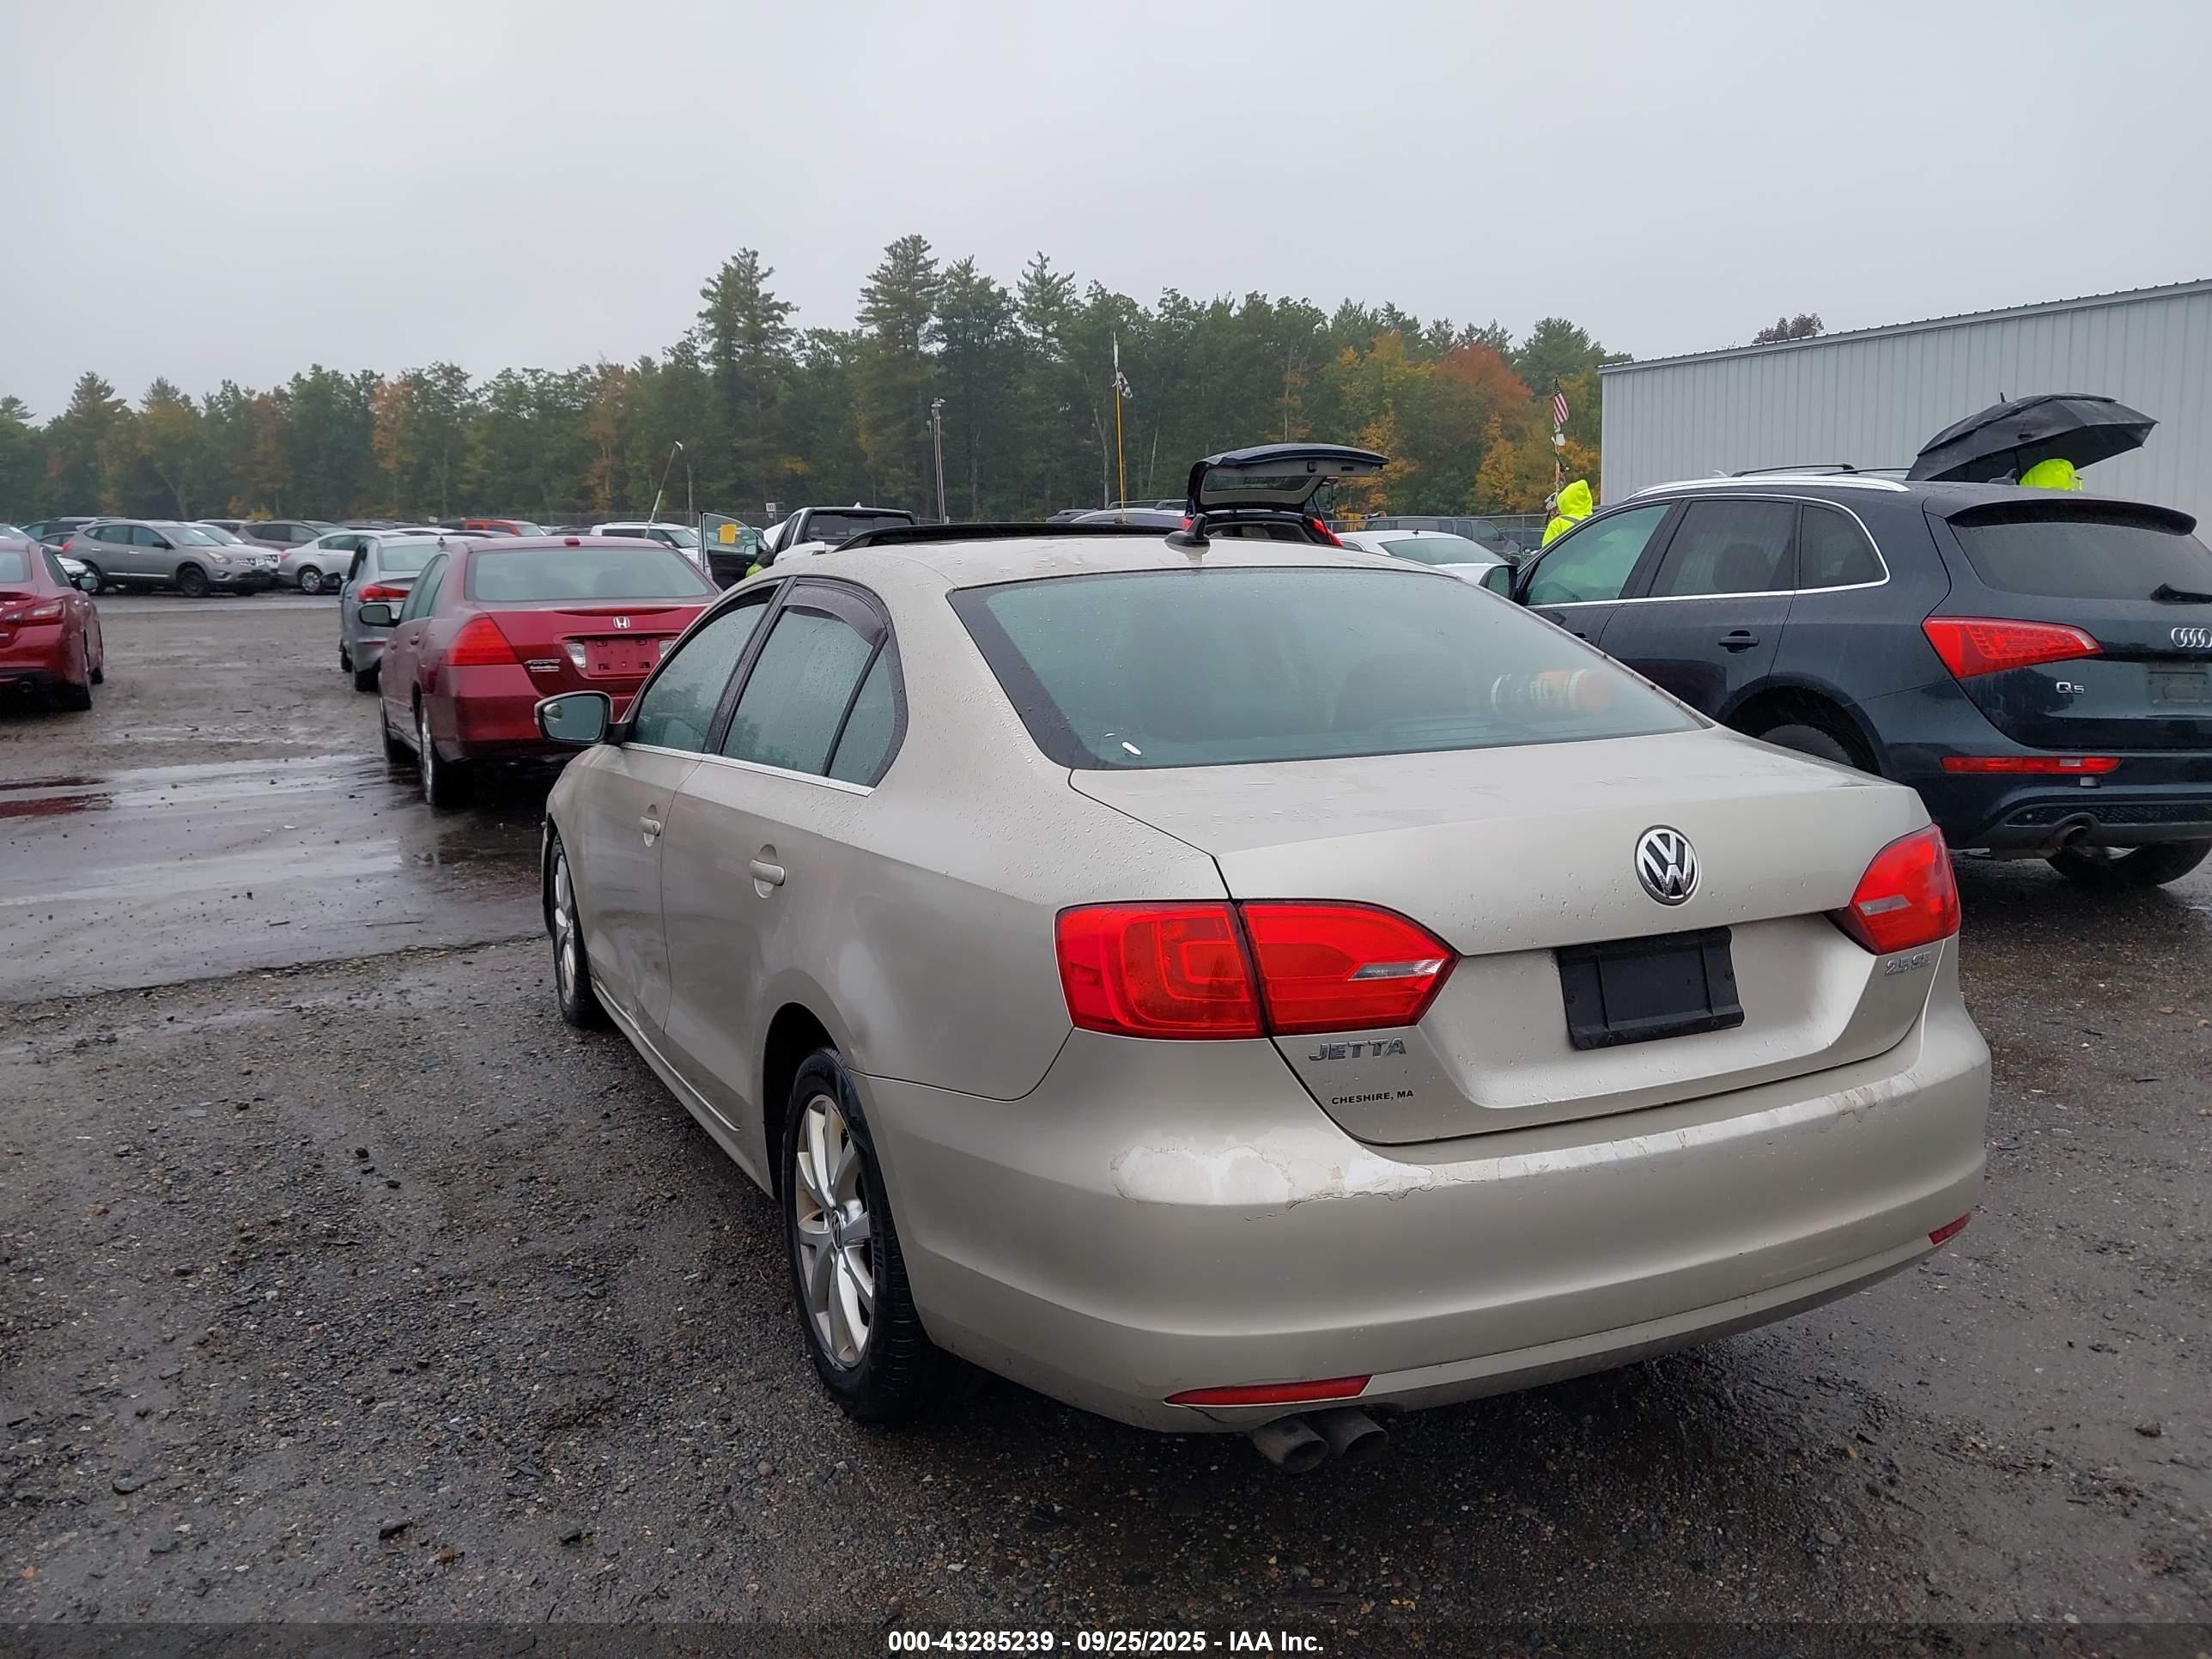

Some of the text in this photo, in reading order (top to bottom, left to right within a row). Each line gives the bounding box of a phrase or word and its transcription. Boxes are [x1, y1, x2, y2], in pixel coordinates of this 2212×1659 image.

[2056, 681, 2085, 694] Q5
[1308, 1037, 1407, 1061] JETTA
[1332, 1090, 1414, 1105] CHESHIRE, MA
